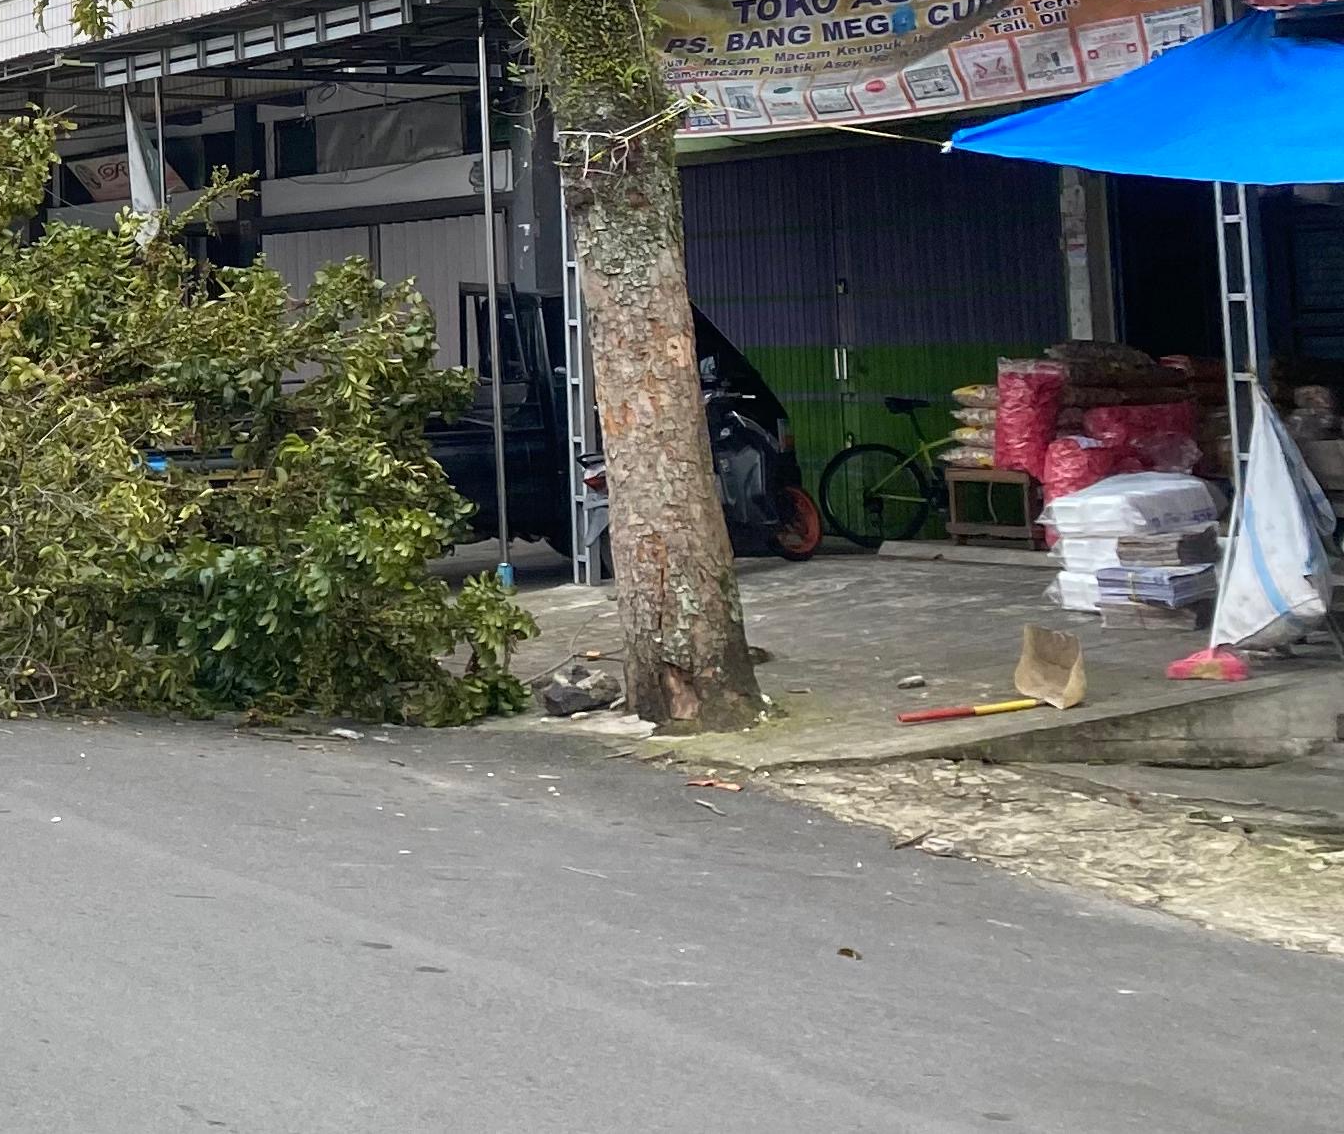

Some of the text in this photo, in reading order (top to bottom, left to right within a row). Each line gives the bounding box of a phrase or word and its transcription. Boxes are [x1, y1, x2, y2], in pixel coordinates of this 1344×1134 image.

[726, 25, 812, 53] BANG
[822, 9, 917, 43] MEG
[775, 50, 830, 62] Macam
